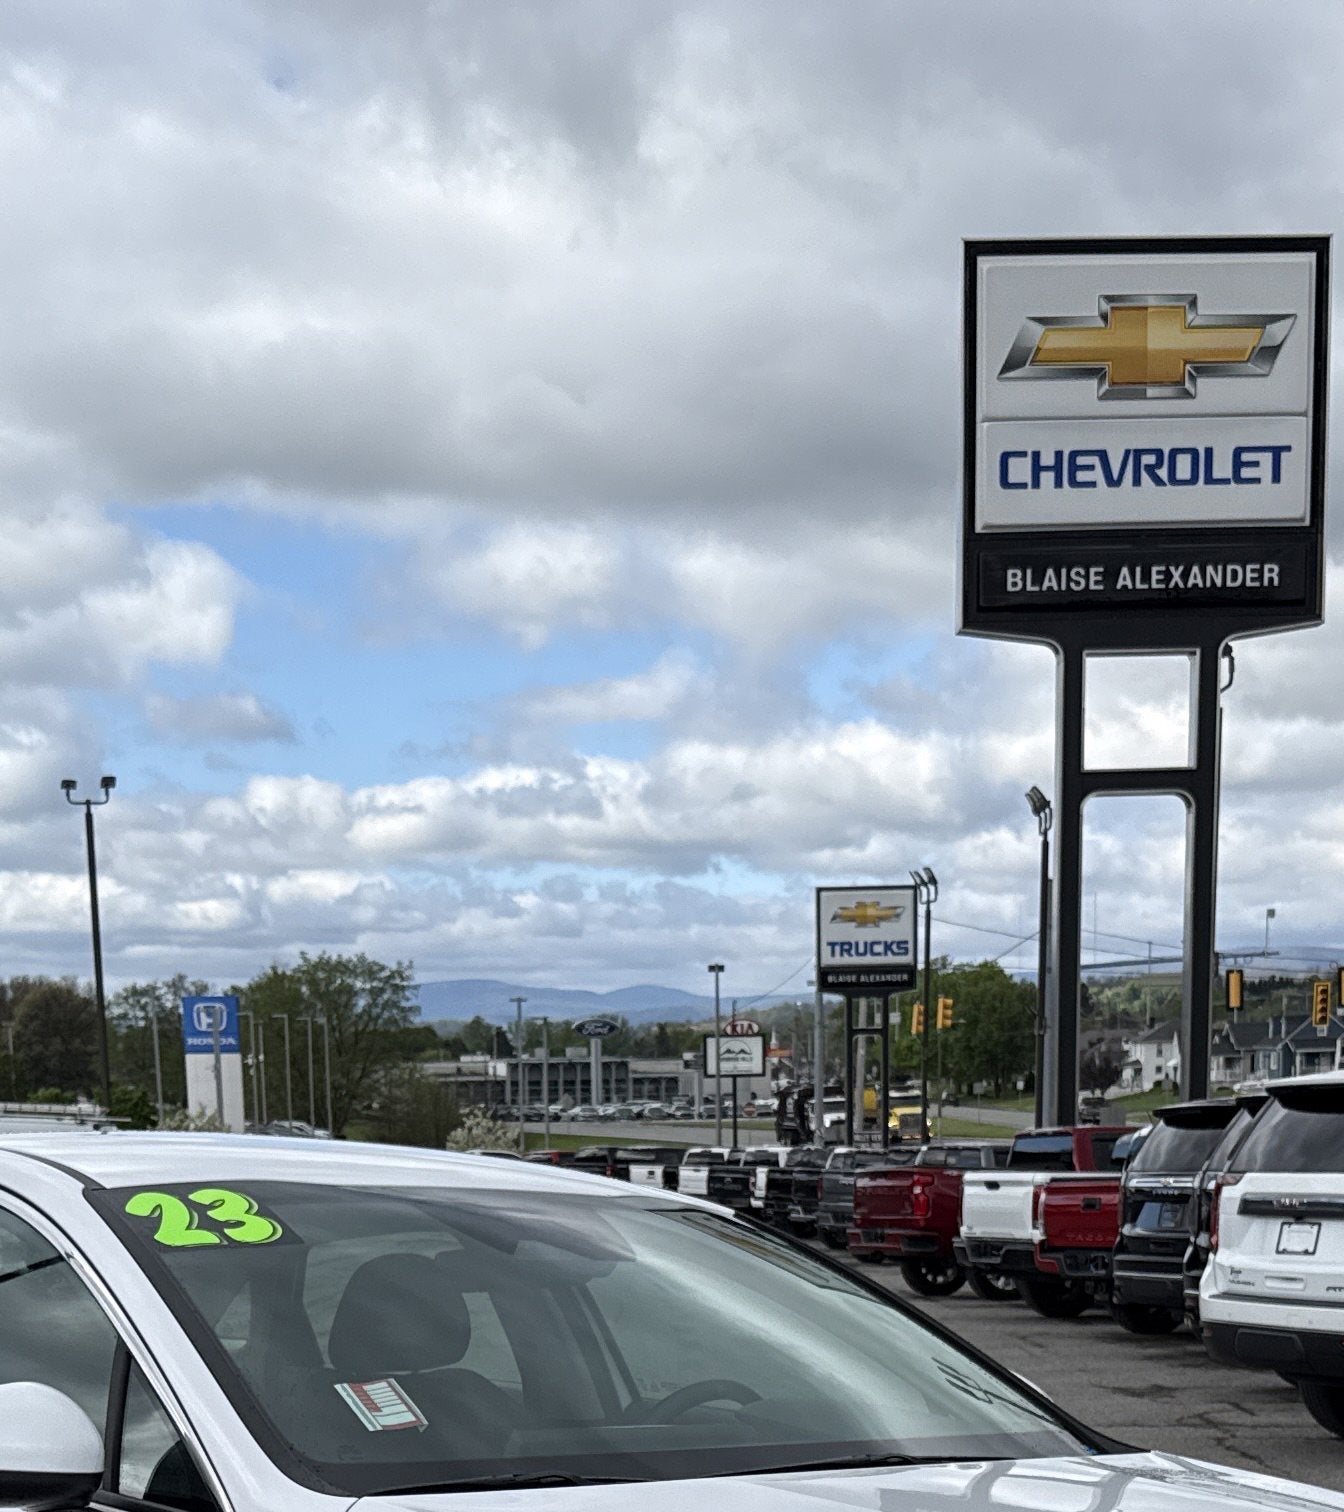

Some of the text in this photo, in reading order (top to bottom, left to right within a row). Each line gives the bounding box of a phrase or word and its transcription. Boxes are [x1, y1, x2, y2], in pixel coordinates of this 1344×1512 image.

[999, 445, 1292, 490] CHEVROLET
[1006, 563, 1280, 592] BLAISE ALEXANDER
[826, 940, 909, 957] TRUCKS
[827, 973, 909, 984] BLAISE ALEXANDER
[731, 1022, 756, 1036] KIA
[124, 1188, 283, 1247] 23
